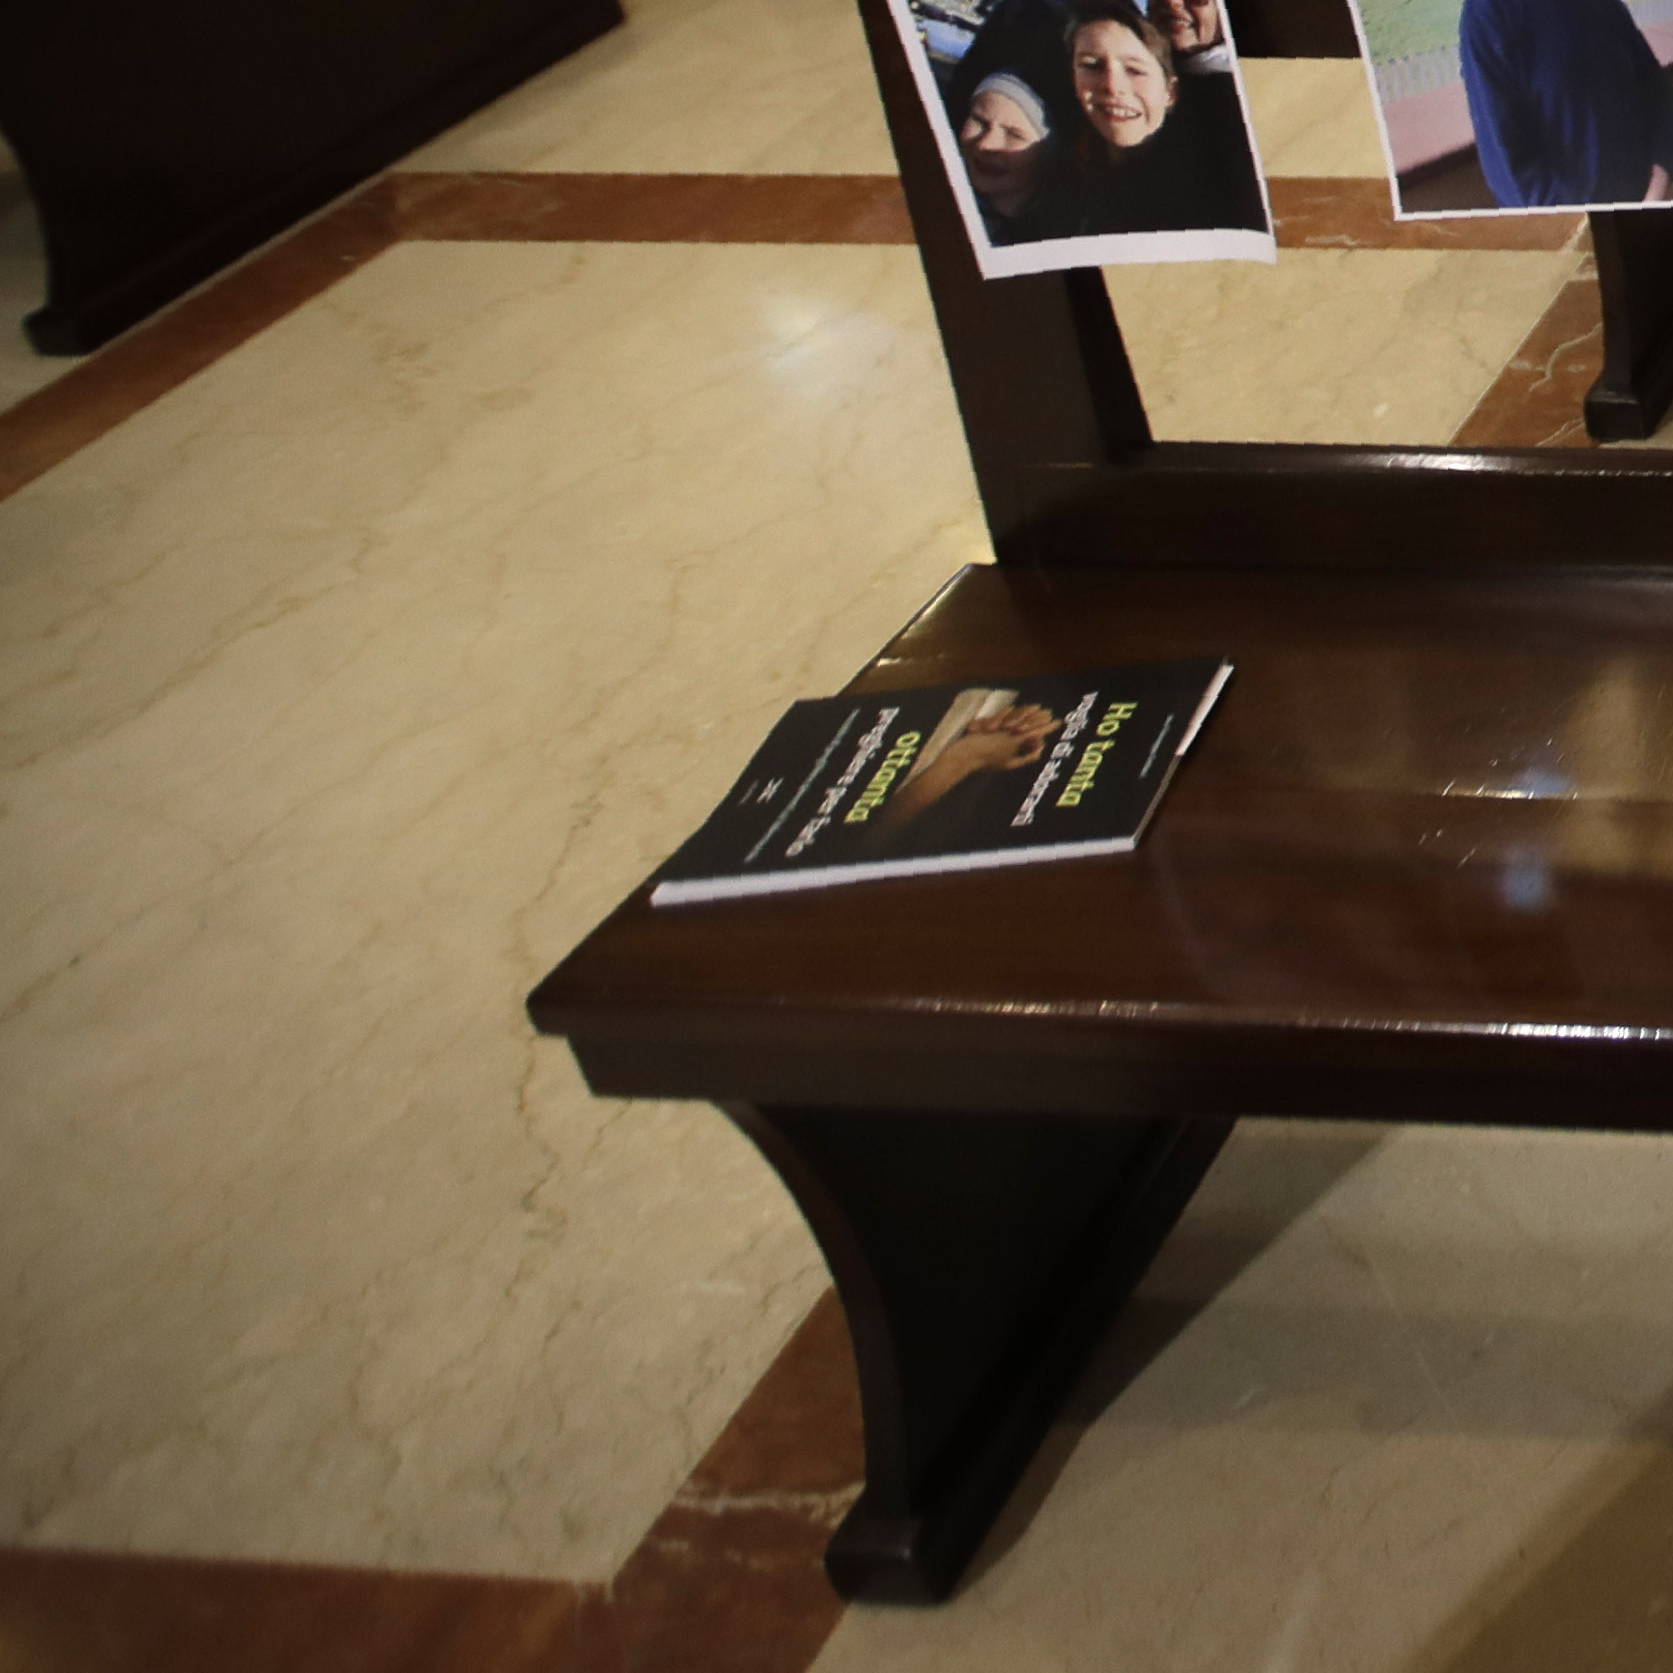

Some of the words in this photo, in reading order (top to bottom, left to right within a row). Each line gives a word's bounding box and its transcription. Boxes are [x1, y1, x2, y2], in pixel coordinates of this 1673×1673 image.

[1056, 692, 1098, 742] voglia
[1096, 703, 1137, 736] Ho
[1050, 742, 1073, 759] di
[1056, 740, 1114, 806] tanta
[845, 732, 920, 823] ottanta
